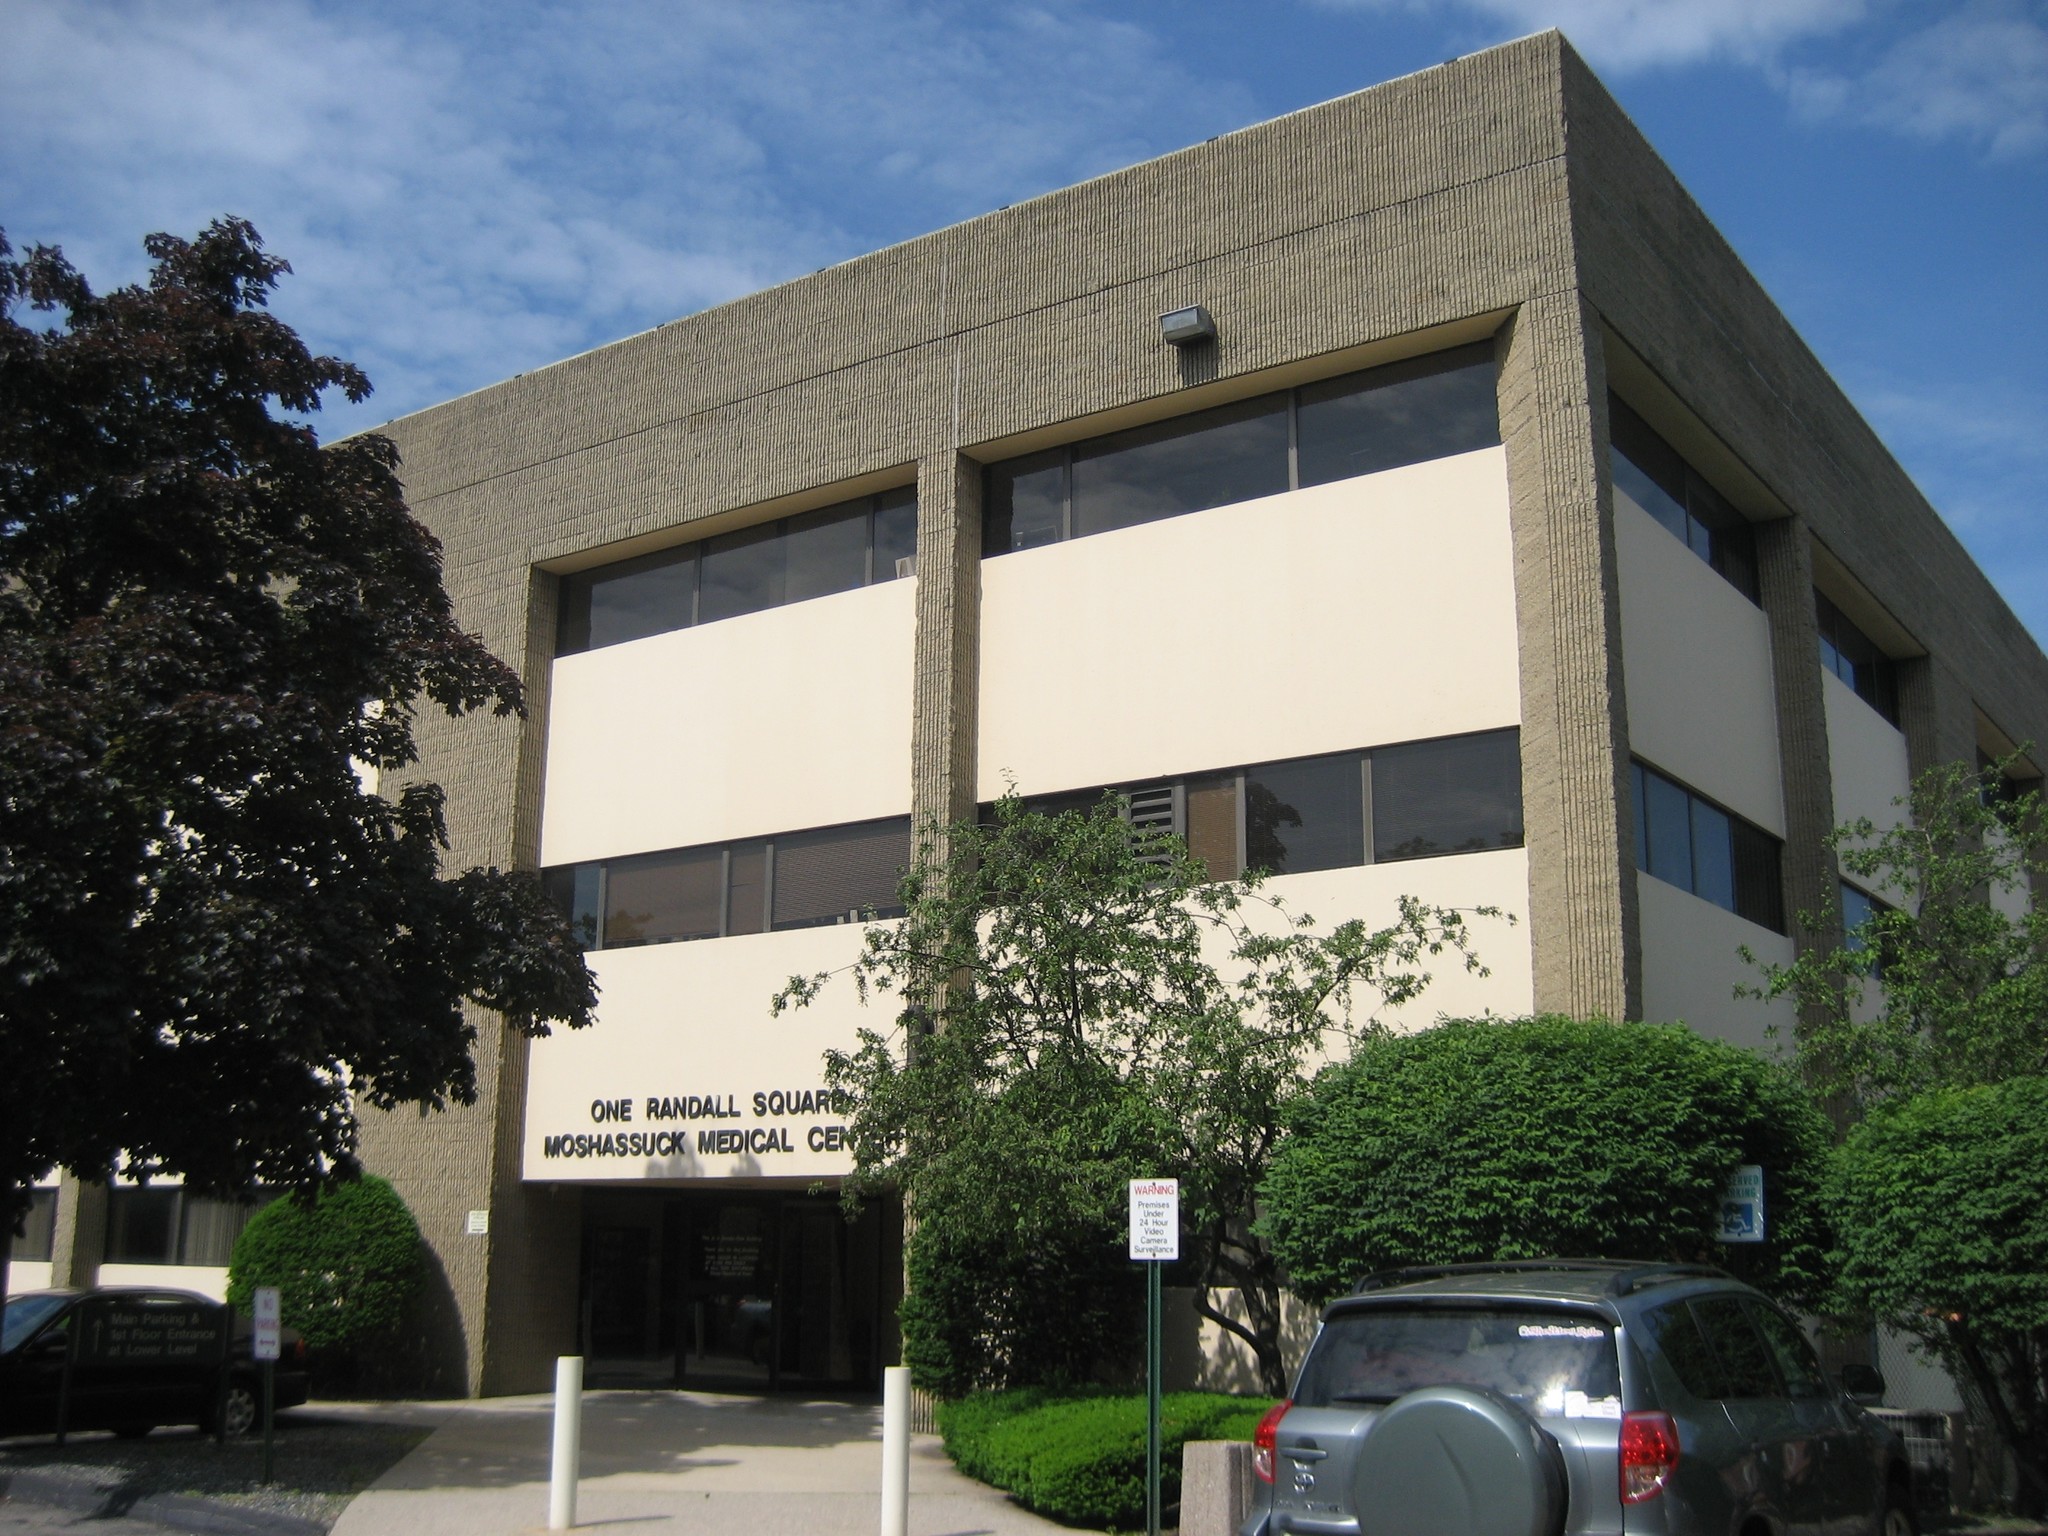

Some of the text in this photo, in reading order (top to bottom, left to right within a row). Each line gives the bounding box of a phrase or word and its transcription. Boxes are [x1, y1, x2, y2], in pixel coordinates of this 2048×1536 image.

[590, 1098, 632, 1123] ONE
[646, 1094, 741, 1121] RANDALL
[544, 1131, 687, 1158] MOSHASSUCK
[698, 1127, 795, 1155] MEDICAL
[1134, 1185, 1174, 1195] WARNING
[1143, 1210, 1164, 1218] Under
[1139, 1219, 1168, 1227] 24 Hour
[1134, 1246, 1174, 1254] Surveillance
[112, 1312, 138, 1325] Main
[143, 1312, 186, 1327] Parking
[132, 1328, 162, 1340] Floor
[167, 1328, 216, 1340] Entrance
[127, 1343, 162, 1355] Lower
[168, 1343, 198, 1354] Level
